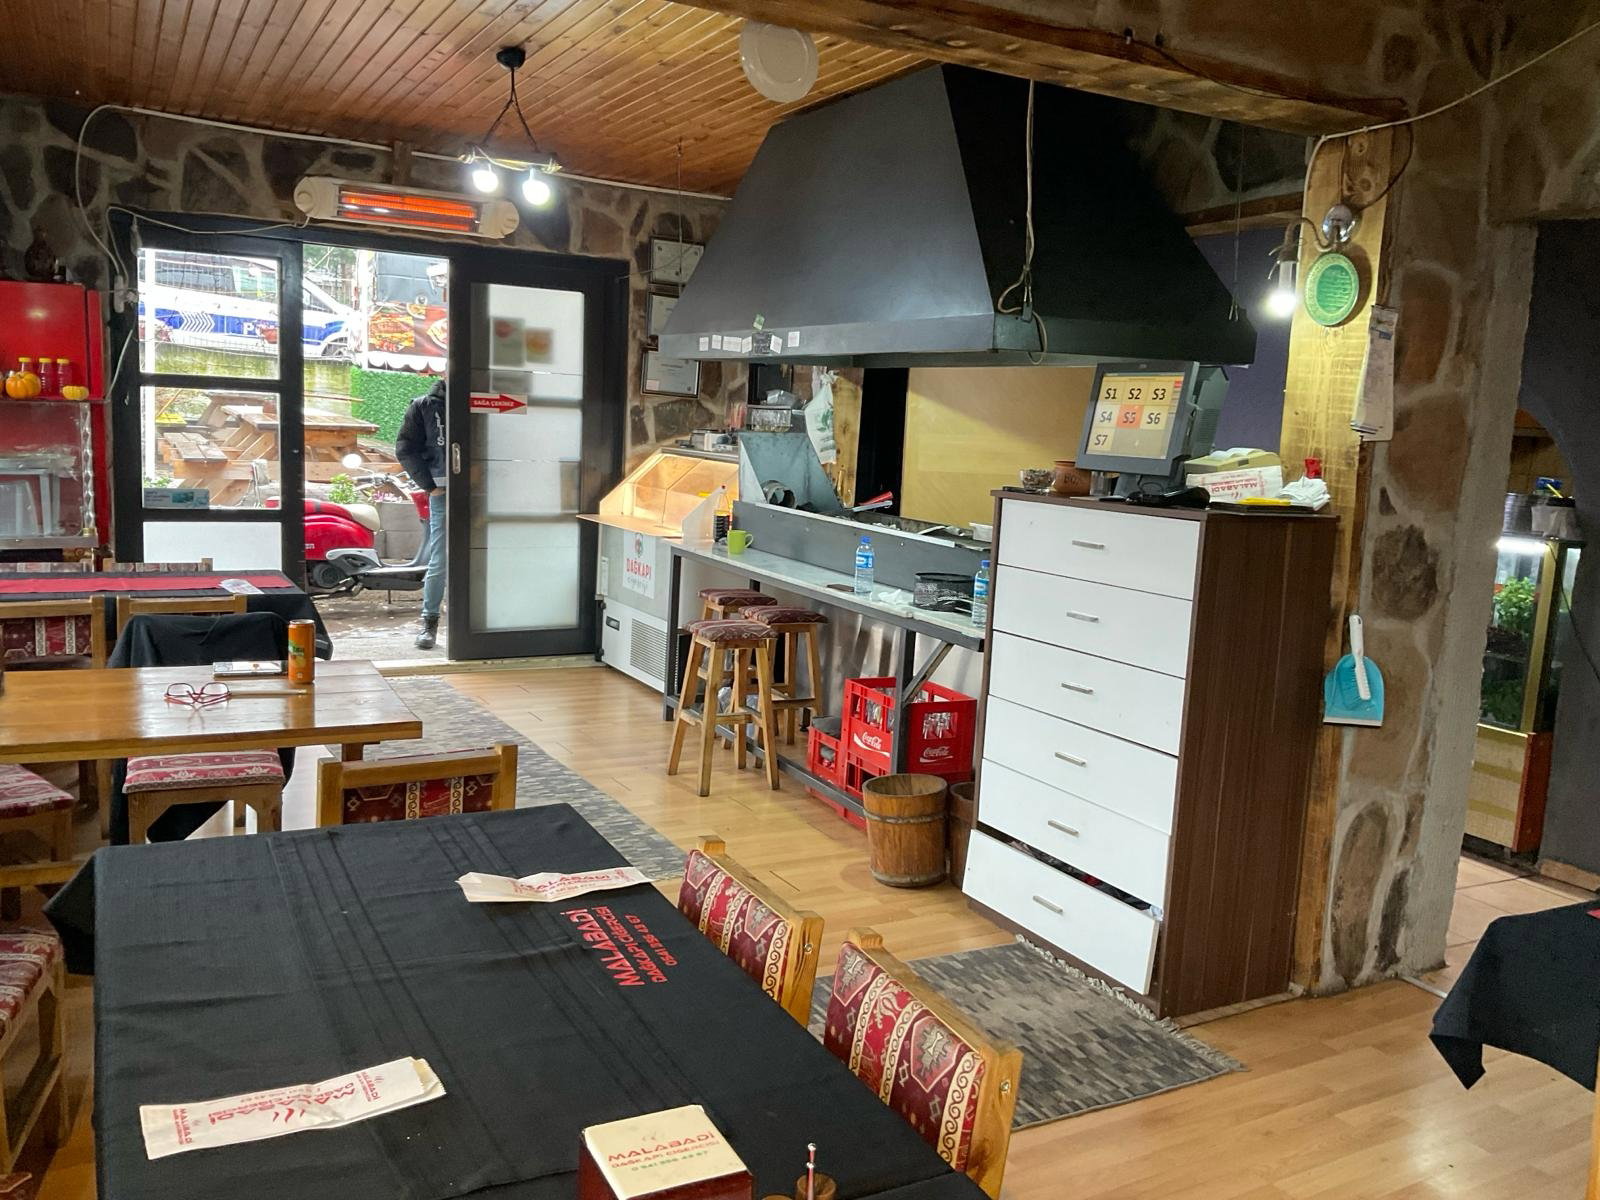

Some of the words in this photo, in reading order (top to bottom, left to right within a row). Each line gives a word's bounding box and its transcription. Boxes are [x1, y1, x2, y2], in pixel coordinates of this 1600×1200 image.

[1104, 388, 1118, 400] S1
[1127, 388, 1142, 400] S2
[1151, 388, 1167, 401] S3
[1099, 411, 1113, 423] S4
[1122, 411, 1137, 424] S5
[1146, 412, 1161, 425] S6
[1094, 434, 1109, 446] S7
[559, 908, 646, 986] MALABADİ
[624, 942, 668, 983] DAĞKAPI
[608, 1131, 716, 1162] MALABADİ
